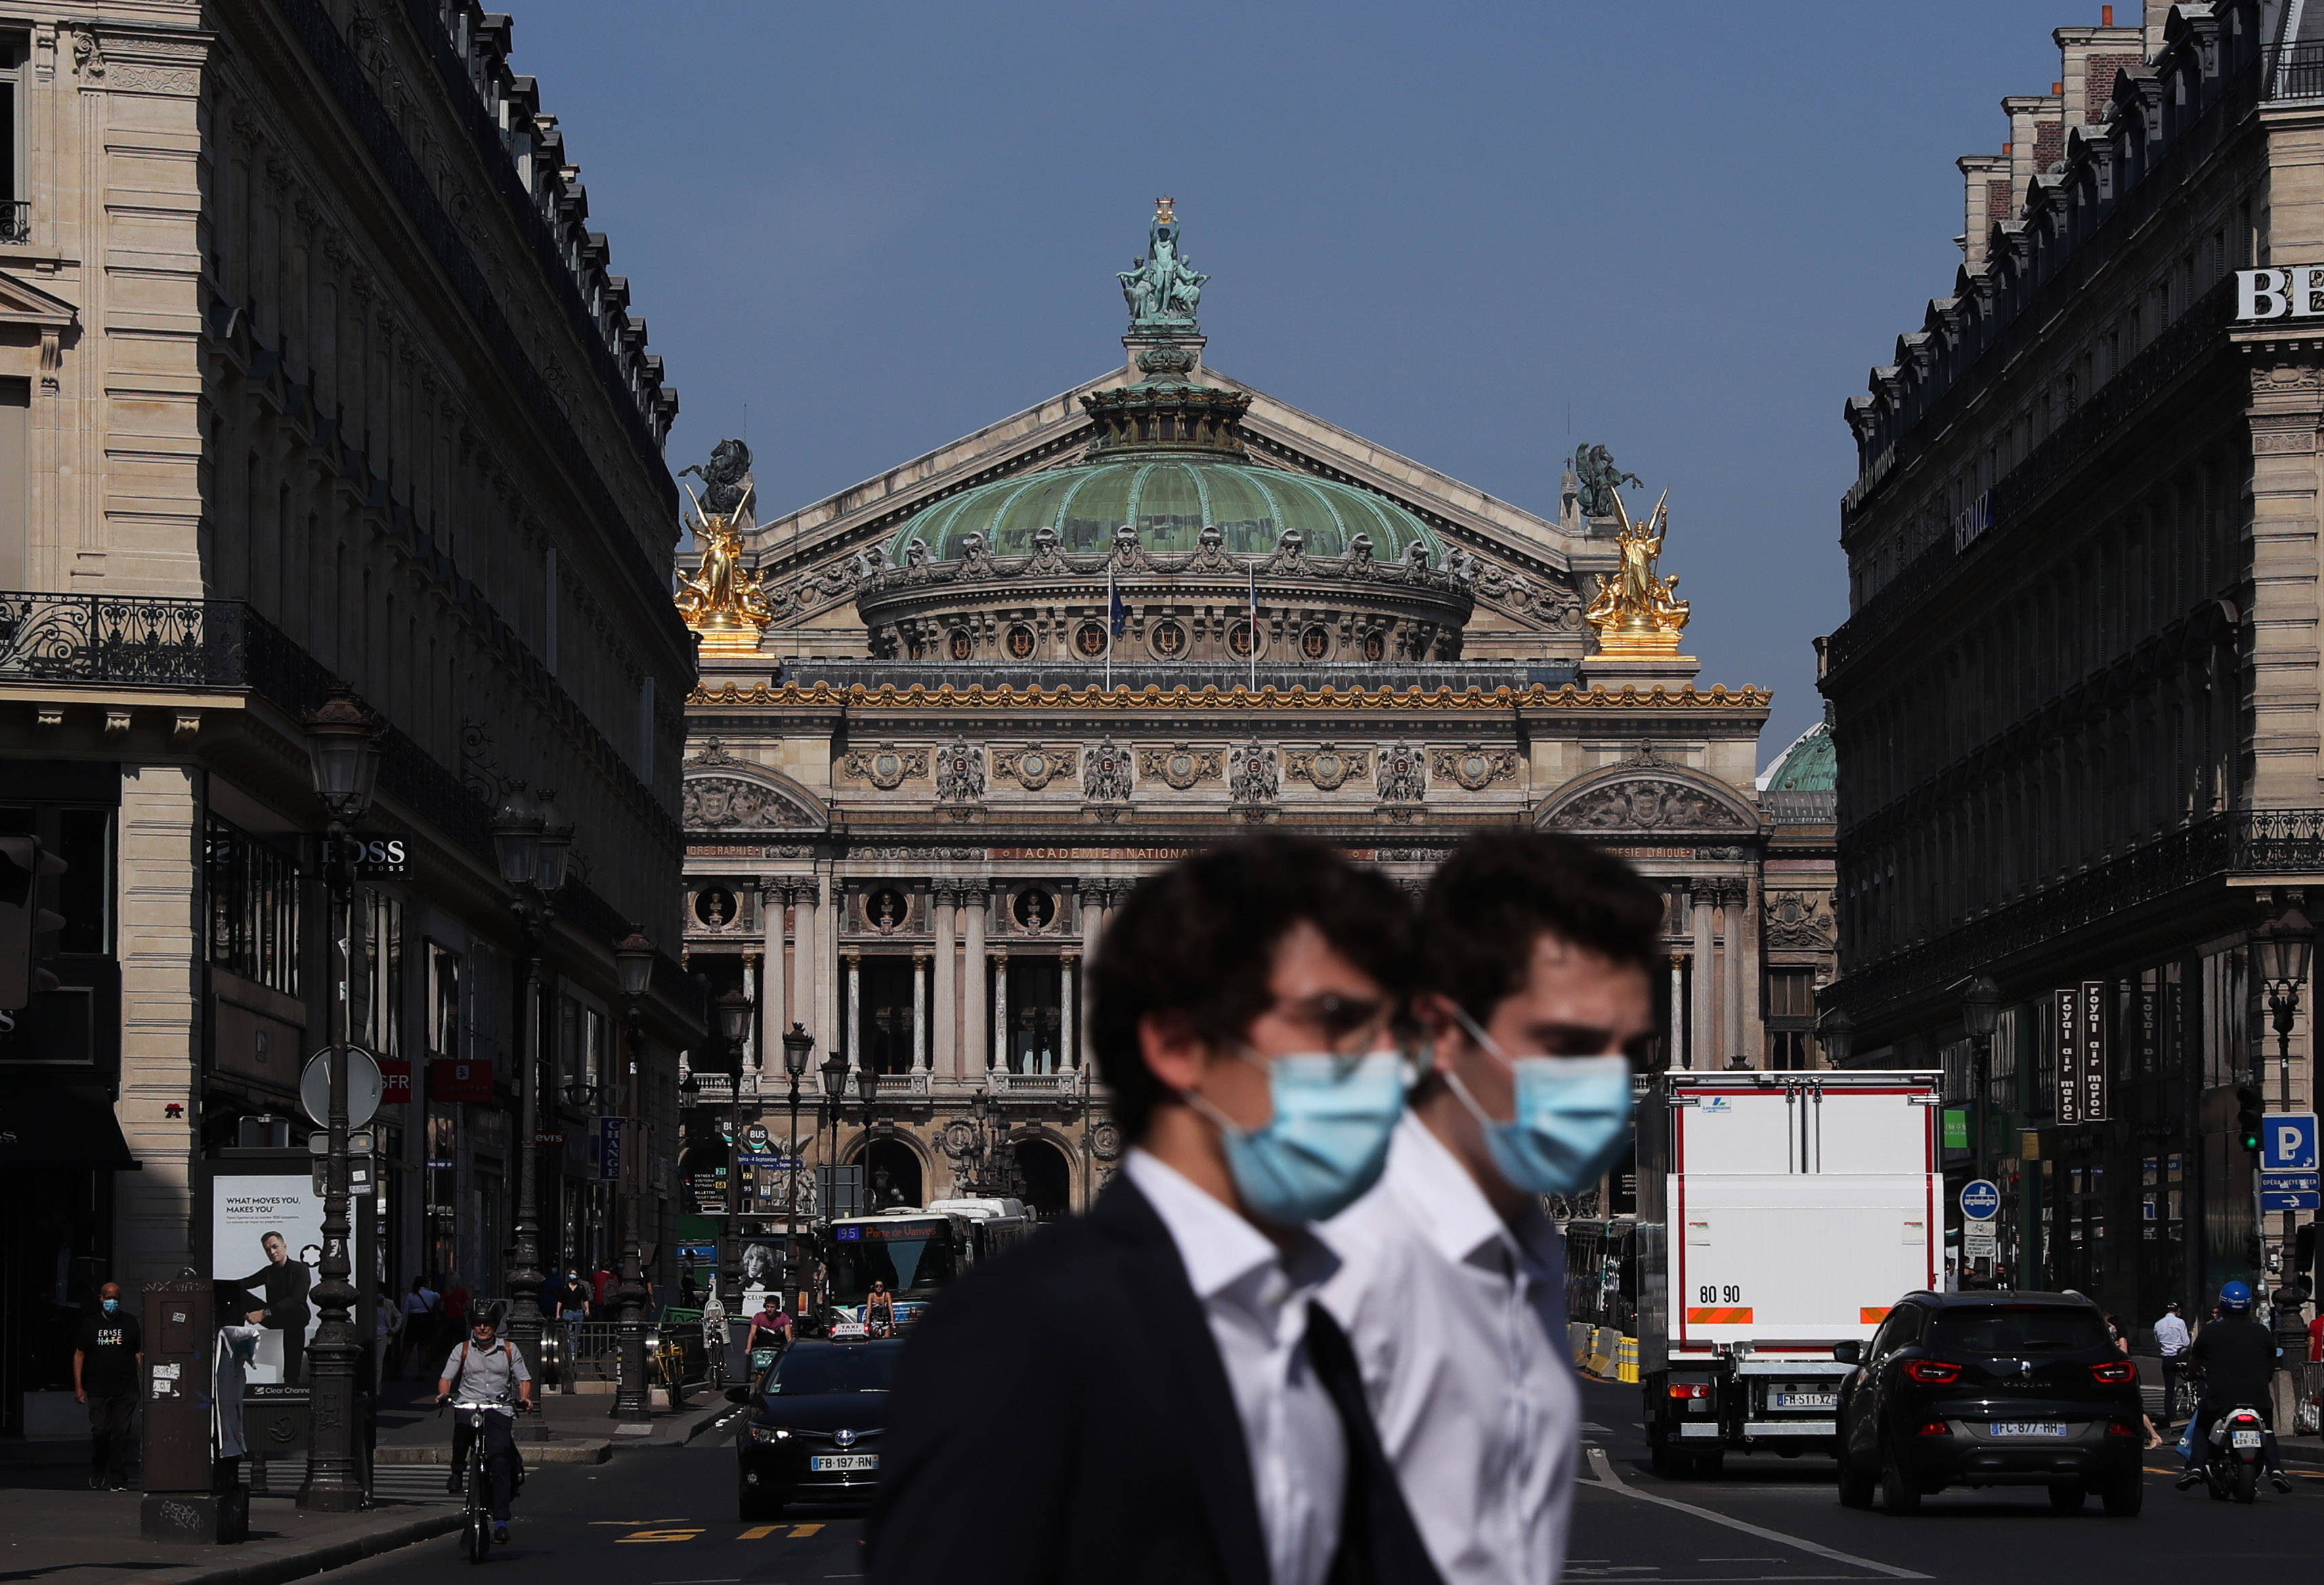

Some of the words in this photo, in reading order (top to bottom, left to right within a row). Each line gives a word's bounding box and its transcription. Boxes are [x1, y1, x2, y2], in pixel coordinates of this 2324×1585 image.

[1955, 490, 1994, 555] BERLITZ
[956, 760, 963, 771] E
[1104, 759, 1111, 771] E
[1250, 761, 1257, 772] E
[1398, 761, 1404, 772] E
[1025, 847, 1110, 859] ACADEMIE
[1646, 848, 1686, 858] LYRIQUE
[2088, 986, 2099, 1033] royal
[2062, 994, 2073, 1040] royal
[2062, 1047, 2073, 1072] air
[2088, 1040, 2100, 1067] air
[381, 1075, 409, 1089] SFR
[2060, 1080, 2074, 1120] maroc
[2087, 1074, 2102, 1116] maroc
[535, 1134, 563, 1143] evi's
[750, 1130, 766, 1139] BUS
[607, 1120, 620, 1177] CHANGE
[2278, 1126, 2302, 1160] P
[282, 1197, 301, 1205] YOU,
[841, 1228, 856, 1239] 95
[866, 1227, 890, 1238] Porte
[892, 1229, 901, 1237] de
[905, 1225, 936, 1236] Vanves
[1700, 1286, 1717, 1303] 80
[1723, 1285, 1740, 1303] 90
[819, 1457, 872, 1468] FB-197-RN
